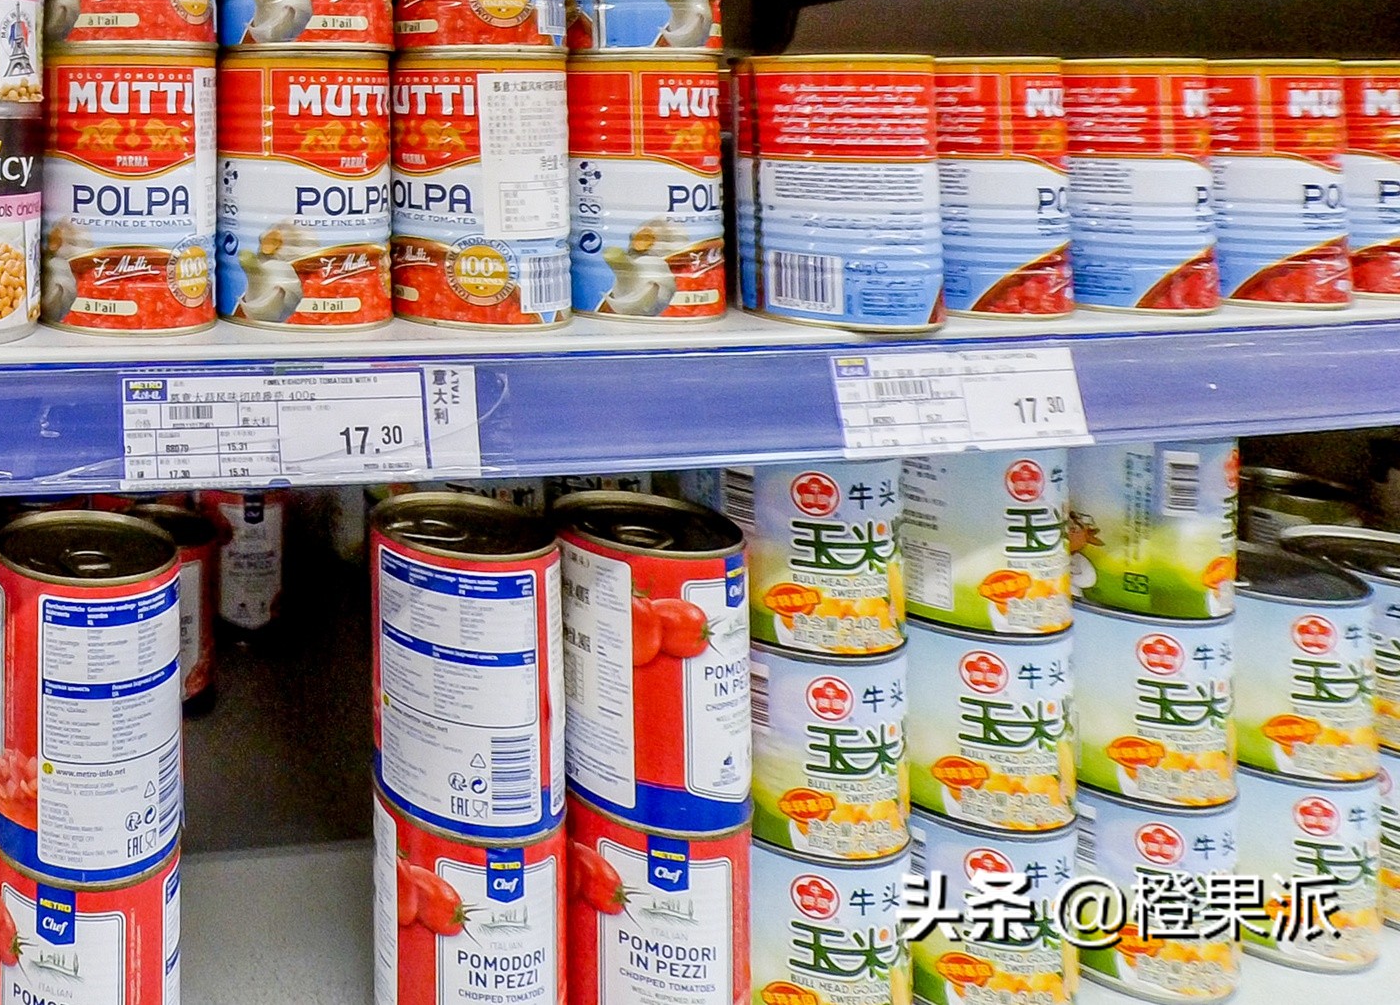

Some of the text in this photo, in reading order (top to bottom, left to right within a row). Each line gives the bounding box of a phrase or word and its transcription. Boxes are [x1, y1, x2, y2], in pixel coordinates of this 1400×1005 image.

[68, 82, 193, 115] MUTTI
[116, 156, 149, 167] PARMA
[72, 184, 190, 216] POLPA
[70, 217, 147, 228] PULPE FINE DE
[428, 215, 477, 225] TOMATES
[128, 380, 163, 390] METRO
[451, 369, 460, 405] ITALY
[432, 370, 449, 425] 意大利
[1014, 396, 1065, 424] 17.30
[227, 441, 249, 451] 15.31
[339, 424, 402, 456] 17.30
[229, 467, 250, 477] 15.31
[848, 480, 896, 510] 牛头
[1018, 663, 1065, 689] 牛头
[55, 768, 126, 778] www.metro-info.net
[493, 875, 518, 894] Chef
[40, 898, 73, 913] METRO
[42, 916, 68, 934] Chef
[618, 929, 717, 962] POMODORI
[457, 949, 546, 973] POMODORI
[628, 951, 708, 979] IN PEZZI
[468, 969, 539, 989] IN PEZZI
[619, 967, 716, 994] CHOPPED TOMATOES
[457, 987, 545, 1004] CHOPPED TOMATOES
